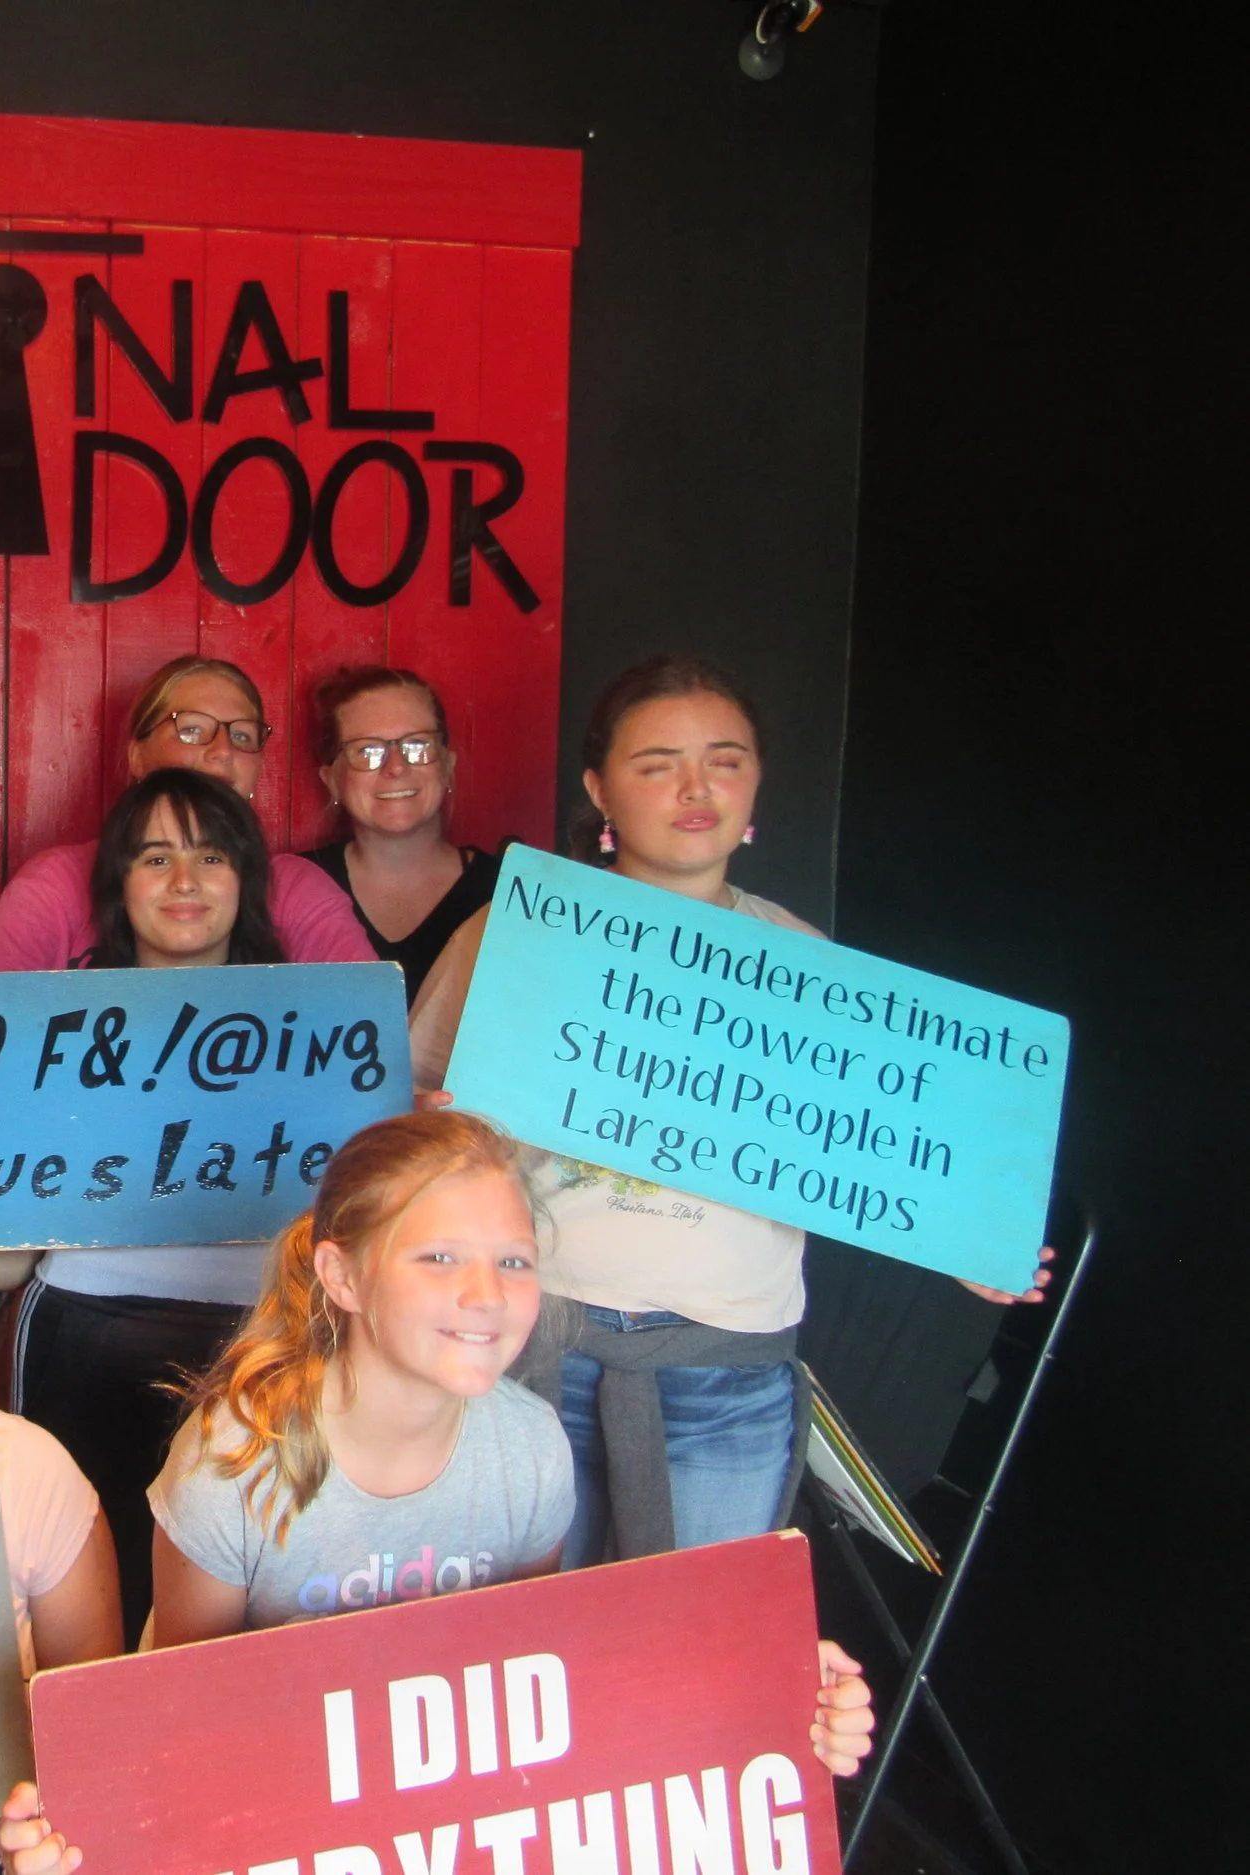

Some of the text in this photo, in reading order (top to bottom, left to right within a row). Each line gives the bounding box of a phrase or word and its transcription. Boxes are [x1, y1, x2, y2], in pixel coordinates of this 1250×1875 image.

[70, 430, 542, 615] DOOR
[505, 875, 1049, 1078] Never Underestimate
[600, 967, 938, 1103] the Power of
[553, 1021, 953, 1177] Stupid People in
[561, 1088, 919, 1232] Large Groups
[298, 1545, 494, 1613] adidas
[323, 1652, 571, 1804] I DID
